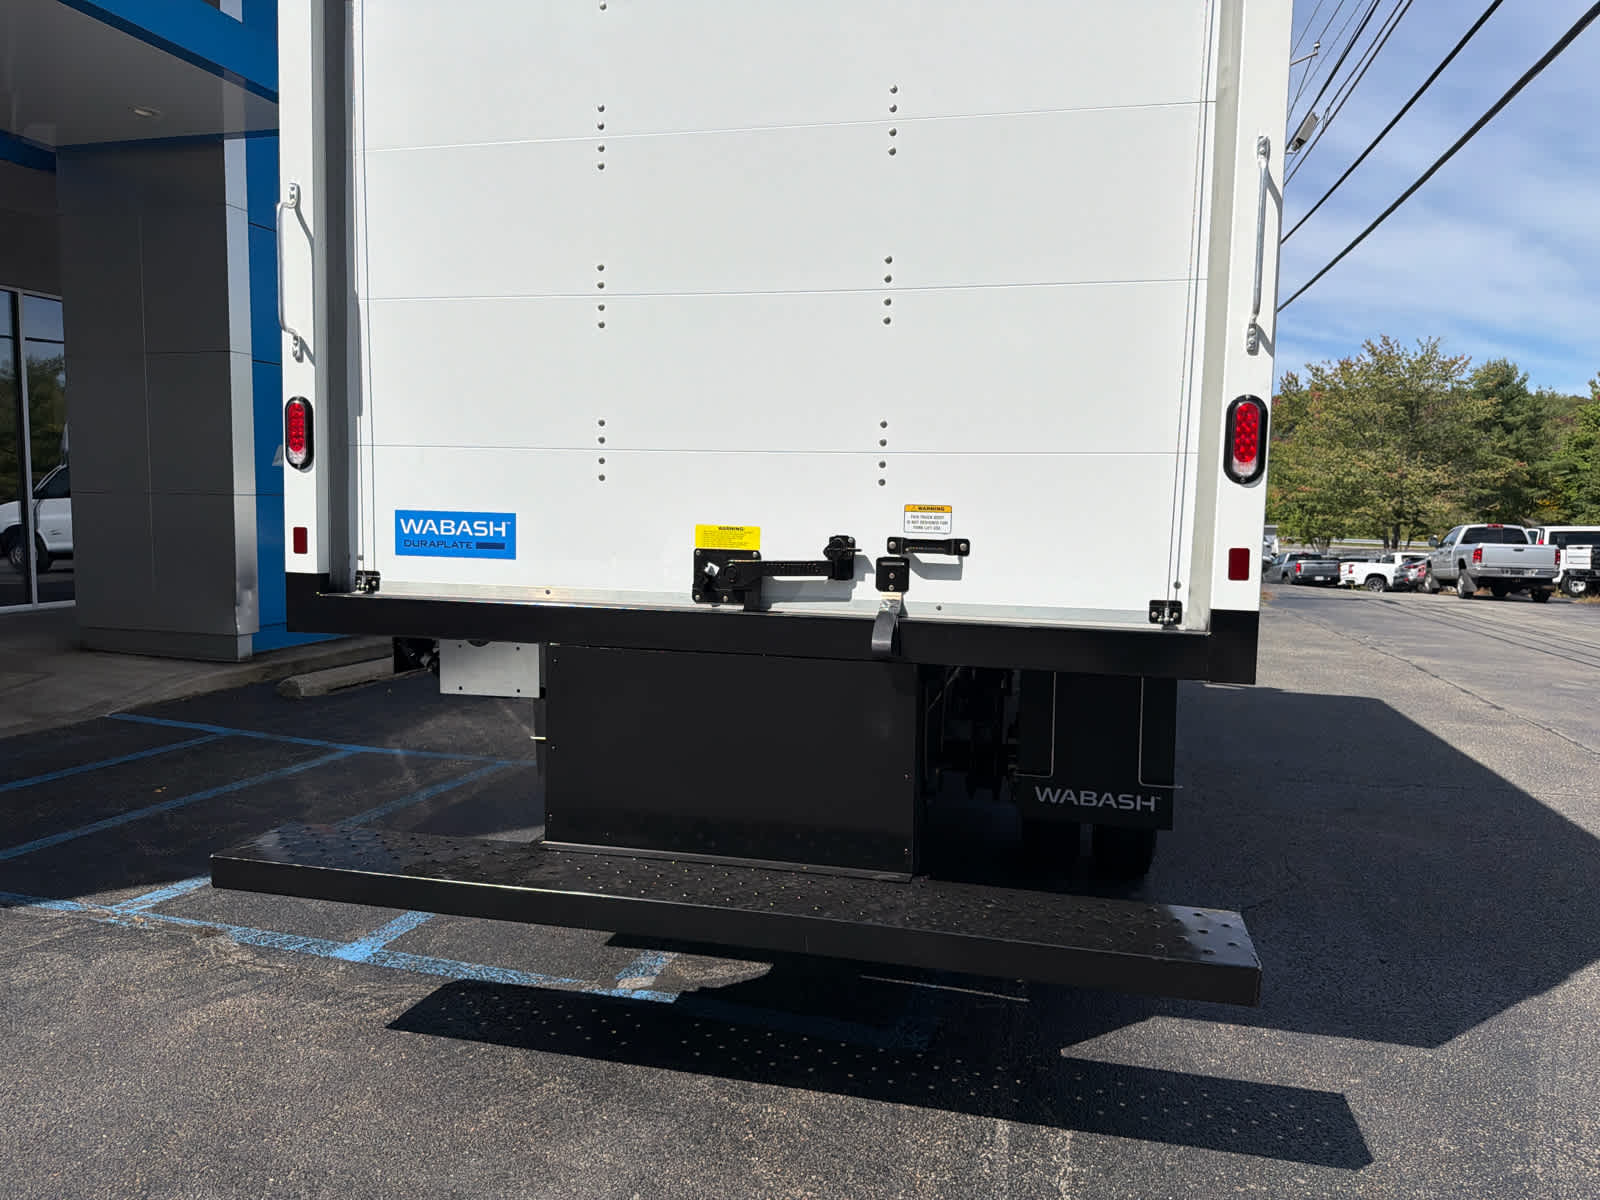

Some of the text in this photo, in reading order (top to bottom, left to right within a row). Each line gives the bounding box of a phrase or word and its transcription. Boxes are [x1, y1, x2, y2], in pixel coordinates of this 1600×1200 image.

[400, 518, 506, 537] WABASH
[403, 539, 472, 550] DURAPLATE
[1034, 786, 1156, 812] WABASH
